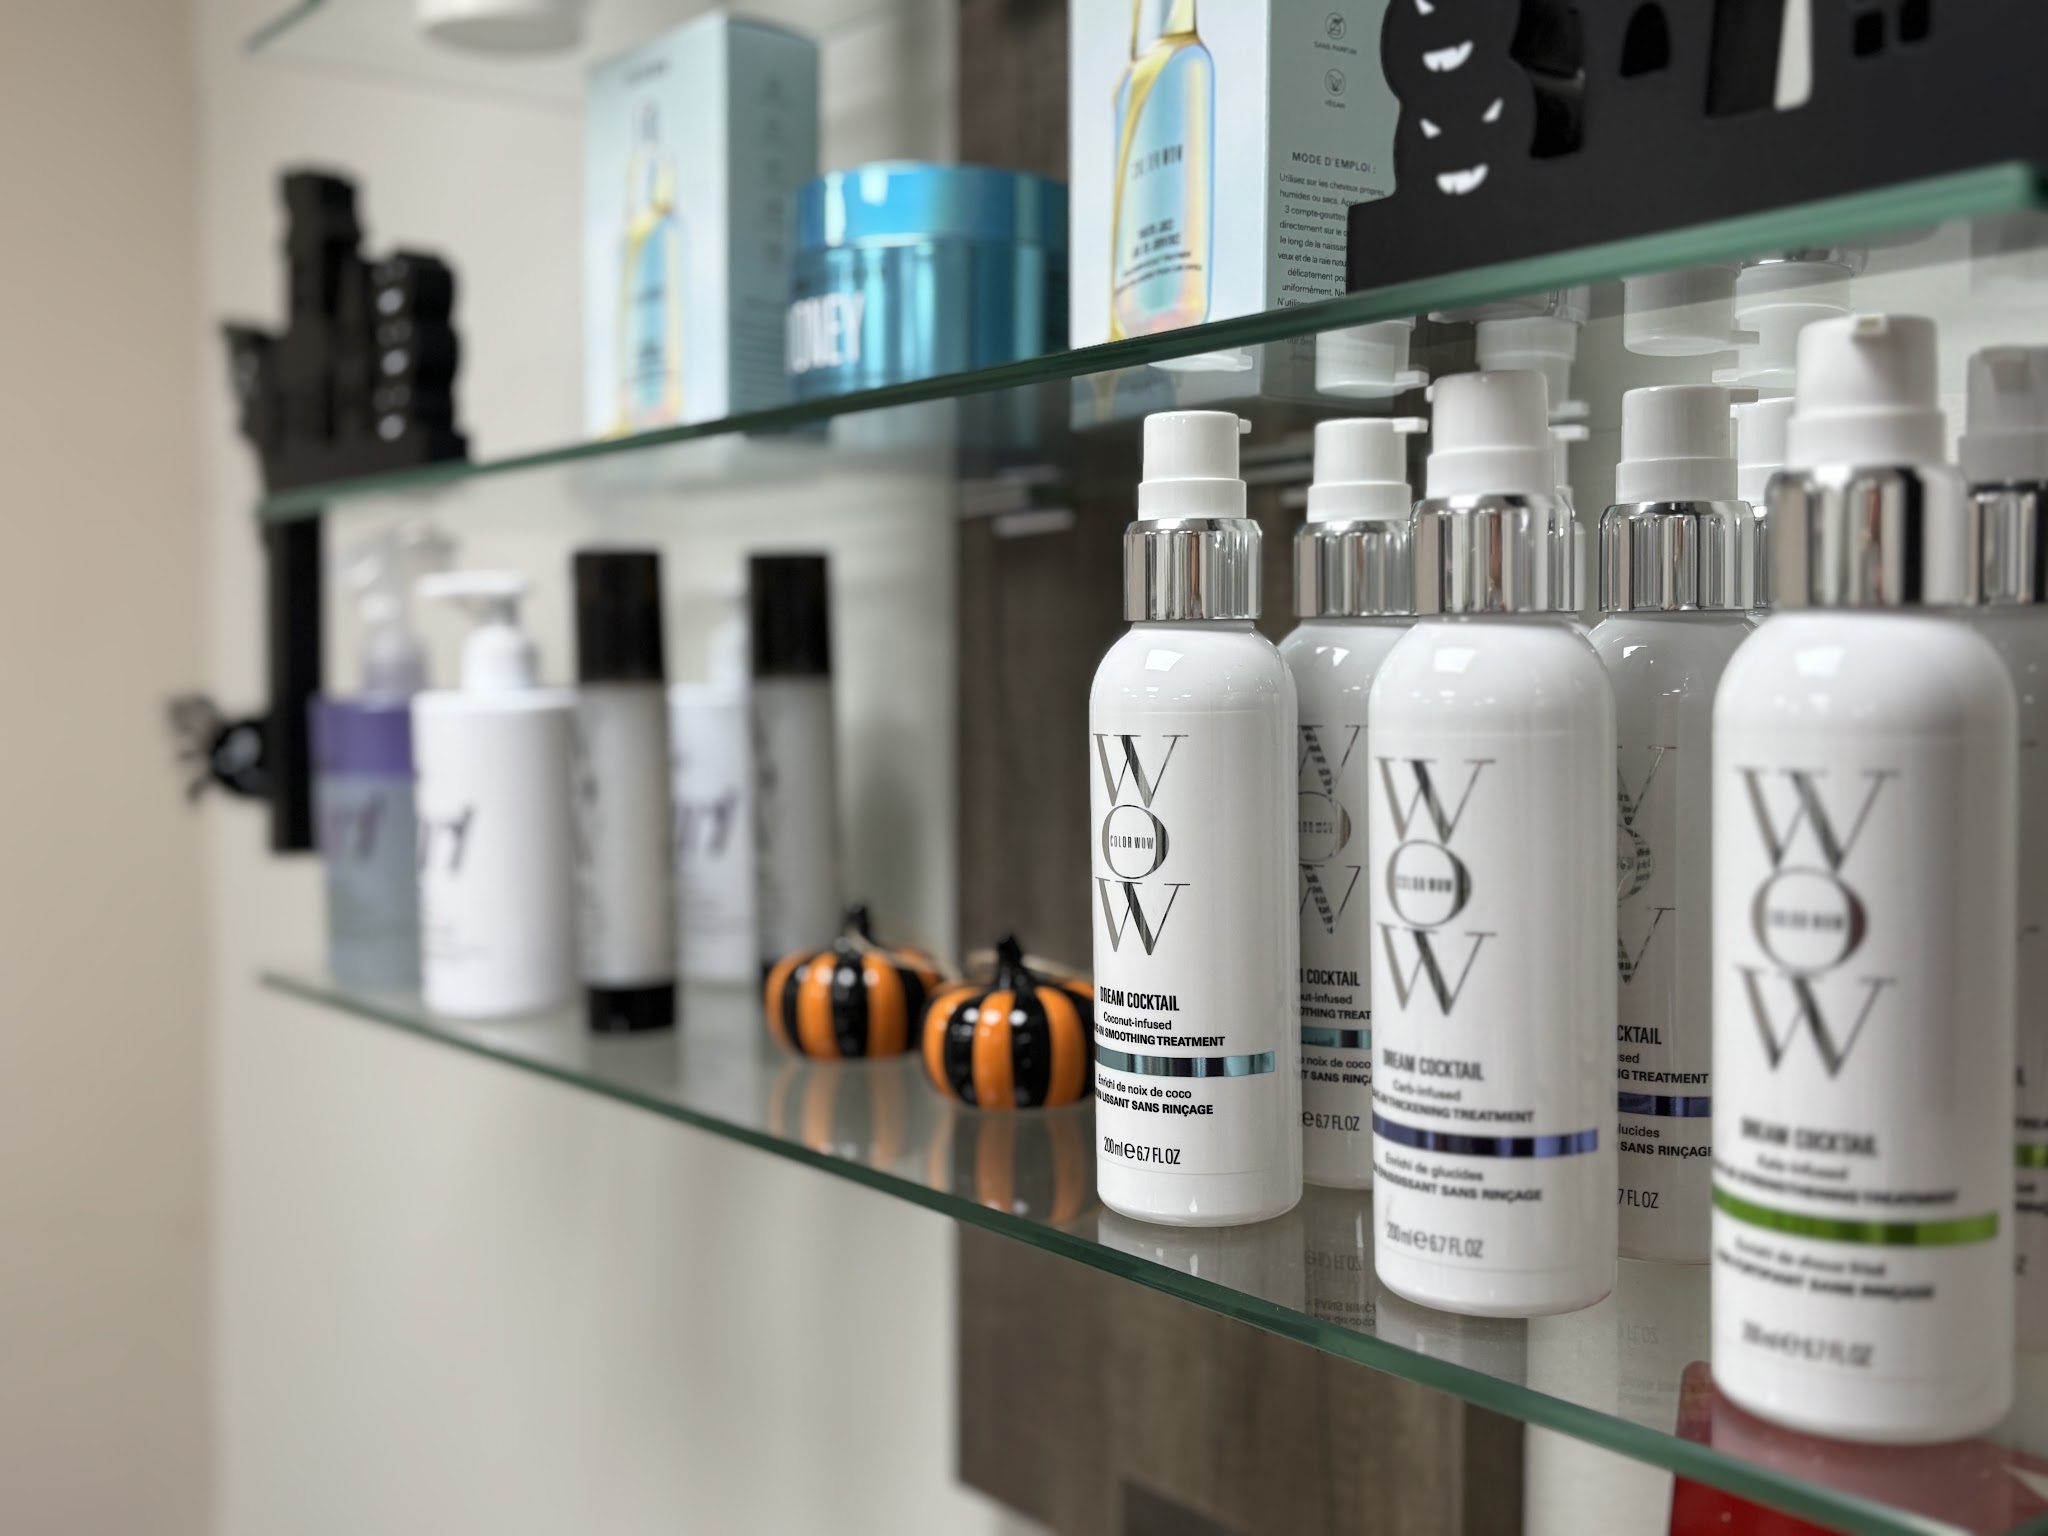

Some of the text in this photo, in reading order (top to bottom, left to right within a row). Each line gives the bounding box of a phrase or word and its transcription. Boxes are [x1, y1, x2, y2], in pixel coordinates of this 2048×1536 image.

[1292, 152, 1322, 166] MODE
[1280, 173, 1305, 185] Utilisez
[1306, 178, 1317, 187] sur
[1319, 179, 1328, 188] les
[1329, 181, 1358, 192] cheveux
[1280, 189, 1310, 201] humides
[1312, 194, 1321, 203] ou
[1285, 205, 1346, 222] 3 compte-gouttes
[1280, 220, 1323, 233] directement
[1324, 227, 1335, 235] sur
[1336, 227, 1342, 236] le
[1280, 236, 1286, 244] le
[1287, 237, 1304, 248] long
[1304, 239, 1313, 248] de
[1314, 240, 1321, 249] la
[1277, 252, 1347, 267] veux et de la raie natu
[1287, 268, 1333, 281] délicatement
[1334, 288, 1345, 297] Ne
[1110, 835, 1154, 850] COLOR WOW
[1306, 969, 1360, 987] COCKTAIL
[1100, 986, 1180, 1011] DREAM COCKTAIL
[1103, 1011, 1172, 1030] Coconut-infused
[1105, 1027, 1155, 1045] SMOOTHING
[1157, 1035, 1225, 1047] TREATMENT
[1617, 1024, 1662, 1045] CKTAIL
[1306, 1056, 1328, 1067] noix
[1330, 1057, 1343, 1068] de
[1346, 1059, 1371, 1070] coco
[1419, 1057, 1484, 1081] COCKTAIL
[1310, 1070, 1339, 1083] SANS
[1631, 1070, 1709, 1084] TREATMENT
[1116, 1081, 1126, 1093] de
[1127, 1085, 1148, 1097] noix
[1150, 1086, 1163, 1098] de
[1166, 1090, 1192, 1099] coco
[1102, 1091, 1130, 1108] LISSANT
[1131, 1100, 1159, 1113] SANS
[1162, 1104, 1214, 1117] RINÇAGE
[1453, 1108, 1535, 1123] TREATMENT
[1618, 1123, 1660, 1138] lucides
[1136, 1145, 1150, 1162] 6.7
[1620, 1141, 1654, 1155] SANS
[1414, 1162, 1428, 1175] de
[1440, 1185, 1478, 1199] SANS
[1482, 1188, 1543, 1204] RINÇAGE
